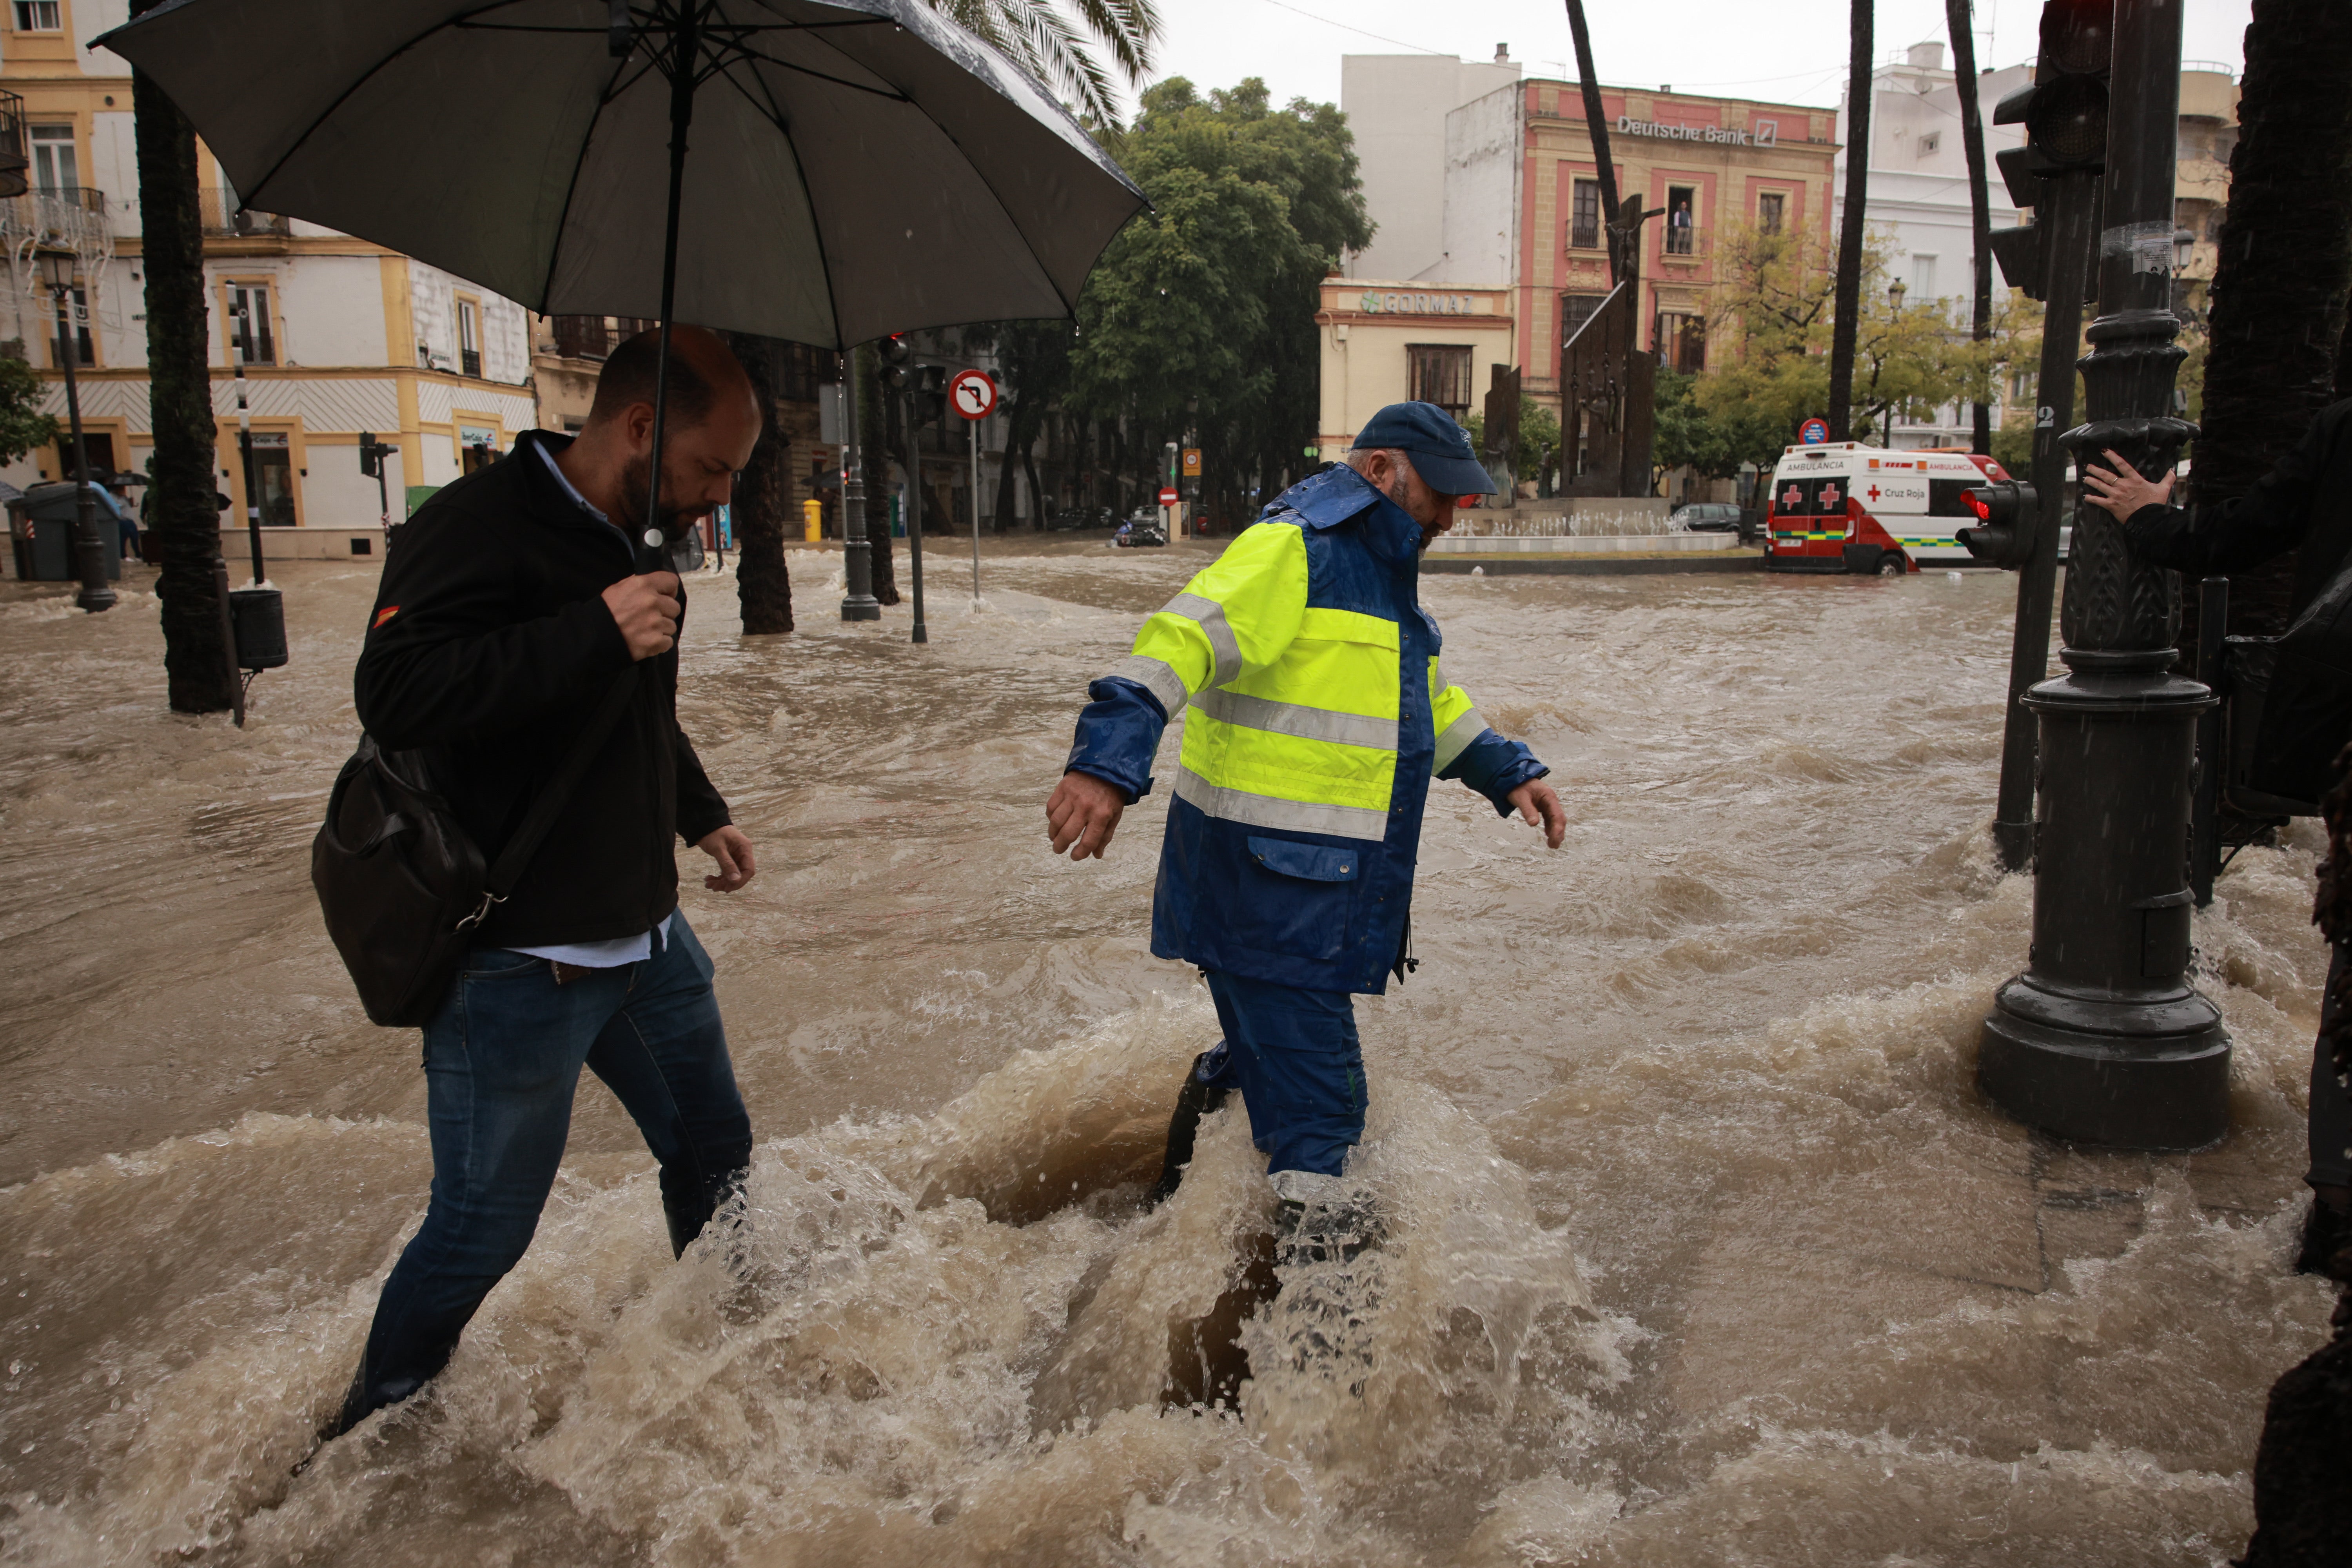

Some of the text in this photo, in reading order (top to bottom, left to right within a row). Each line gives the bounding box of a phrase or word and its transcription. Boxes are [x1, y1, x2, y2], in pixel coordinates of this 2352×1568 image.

[1617, 115, 1747, 145] Deutsche Bank
[1384, 292, 1474, 314] GORMAZ
[2037, 406, 2054, 428] 2
[1786, 461, 1844, 471] AMBULANCIA
[1885, 488, 1925, 500] Cruz Roja
